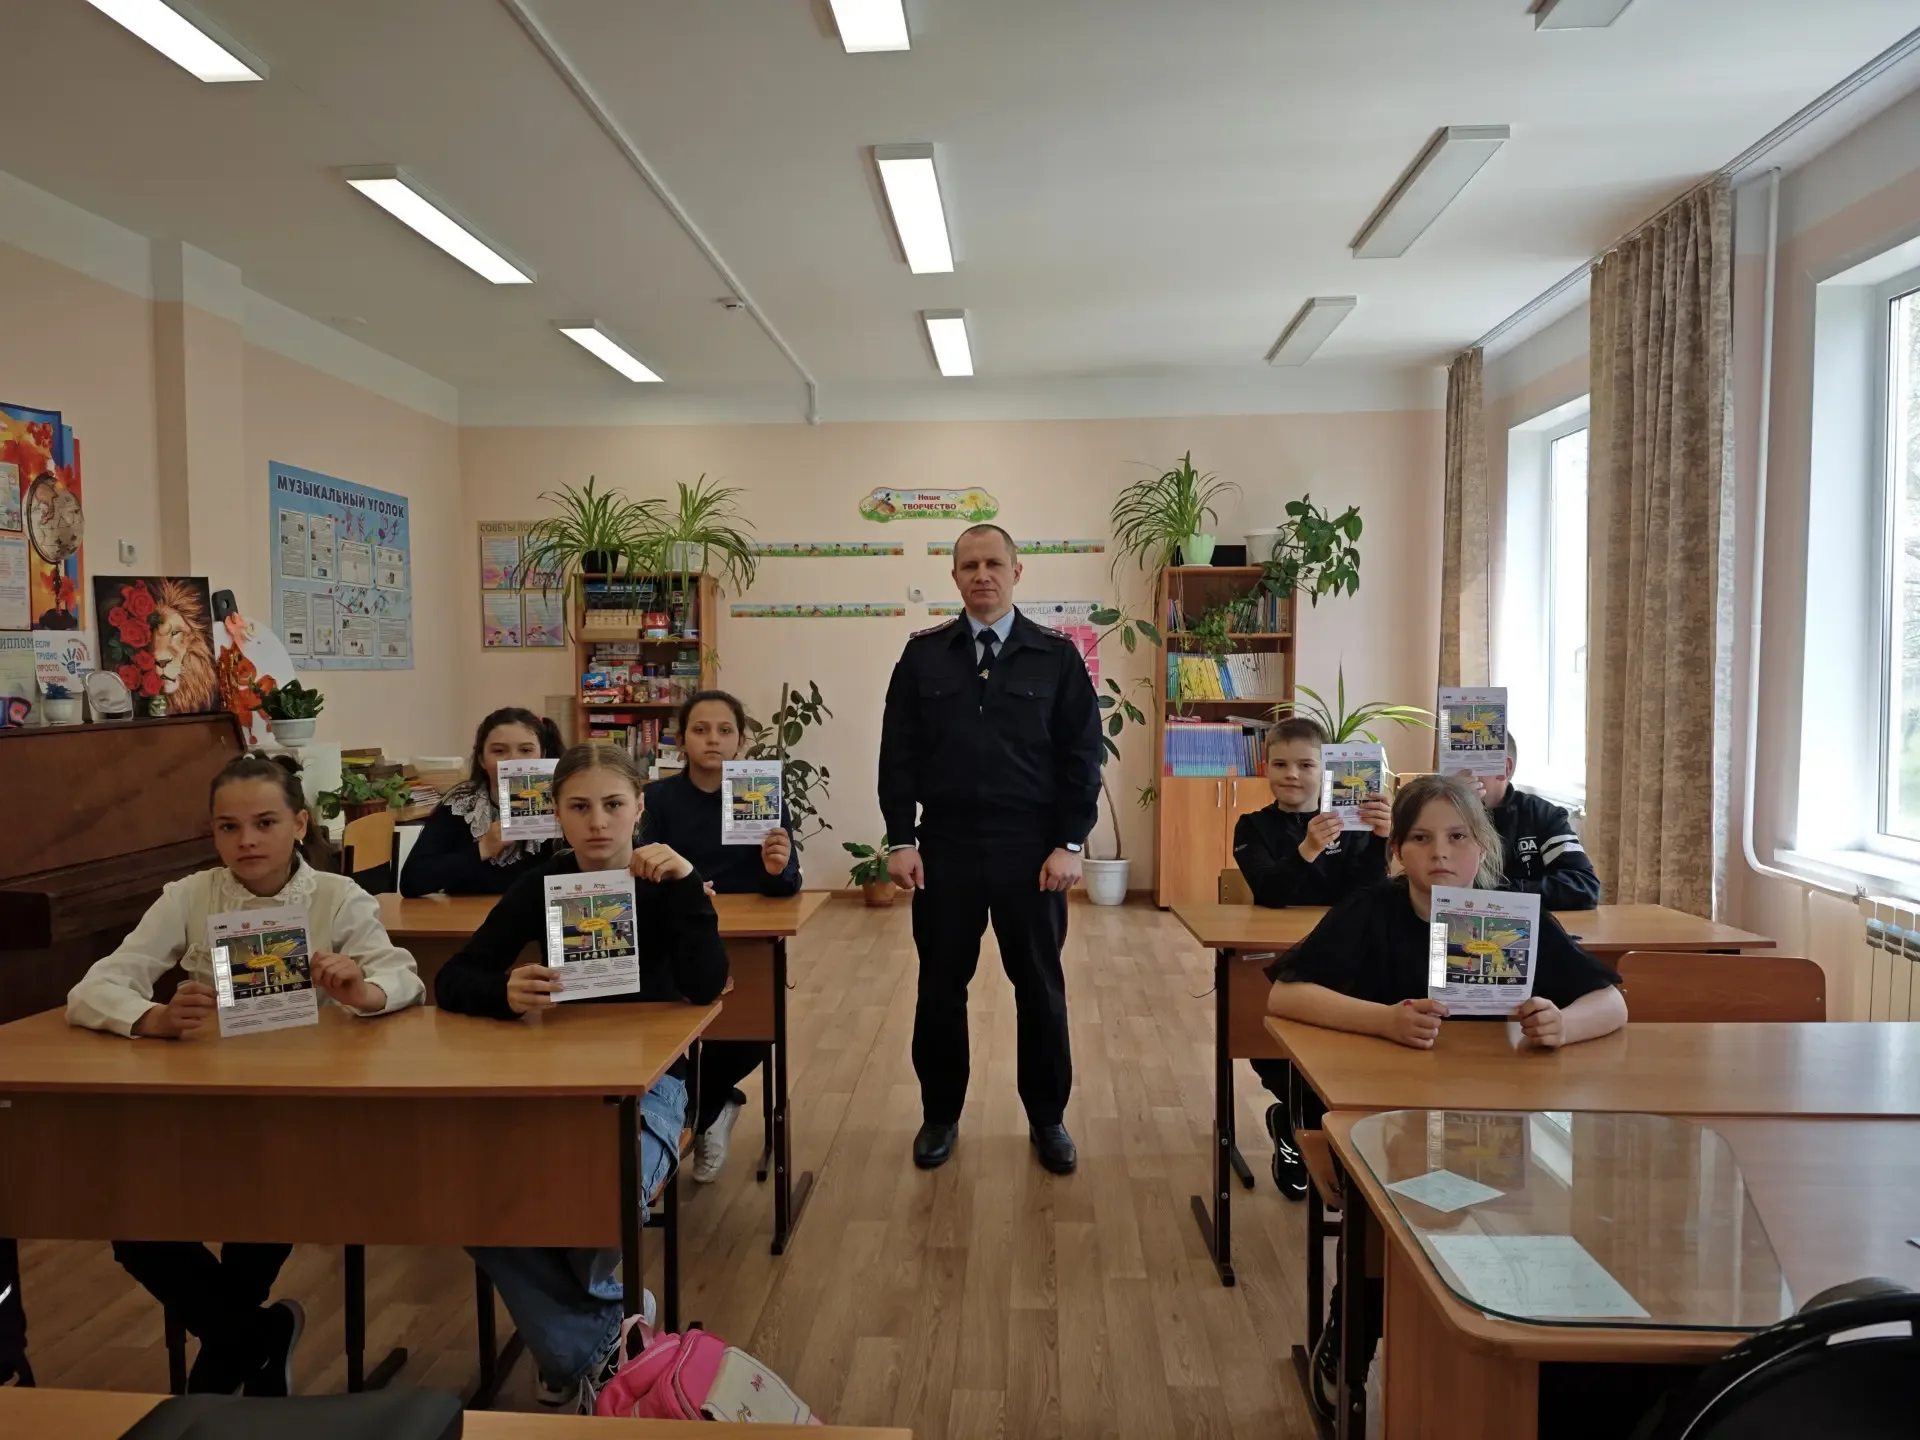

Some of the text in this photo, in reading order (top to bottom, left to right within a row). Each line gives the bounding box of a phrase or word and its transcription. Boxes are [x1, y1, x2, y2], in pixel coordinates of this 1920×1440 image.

[277, 475, 405, 518] МУЗЫКАЛЬНЫЙ УГОЛОК
[480, 522, 516, 532] СОВЕТЫ
[0, 637, 34, 649] ИПЛОМ
[35, 640, 50, 648] ЕСЛИ
[36, 664, 60, 672] ПРОСТО
